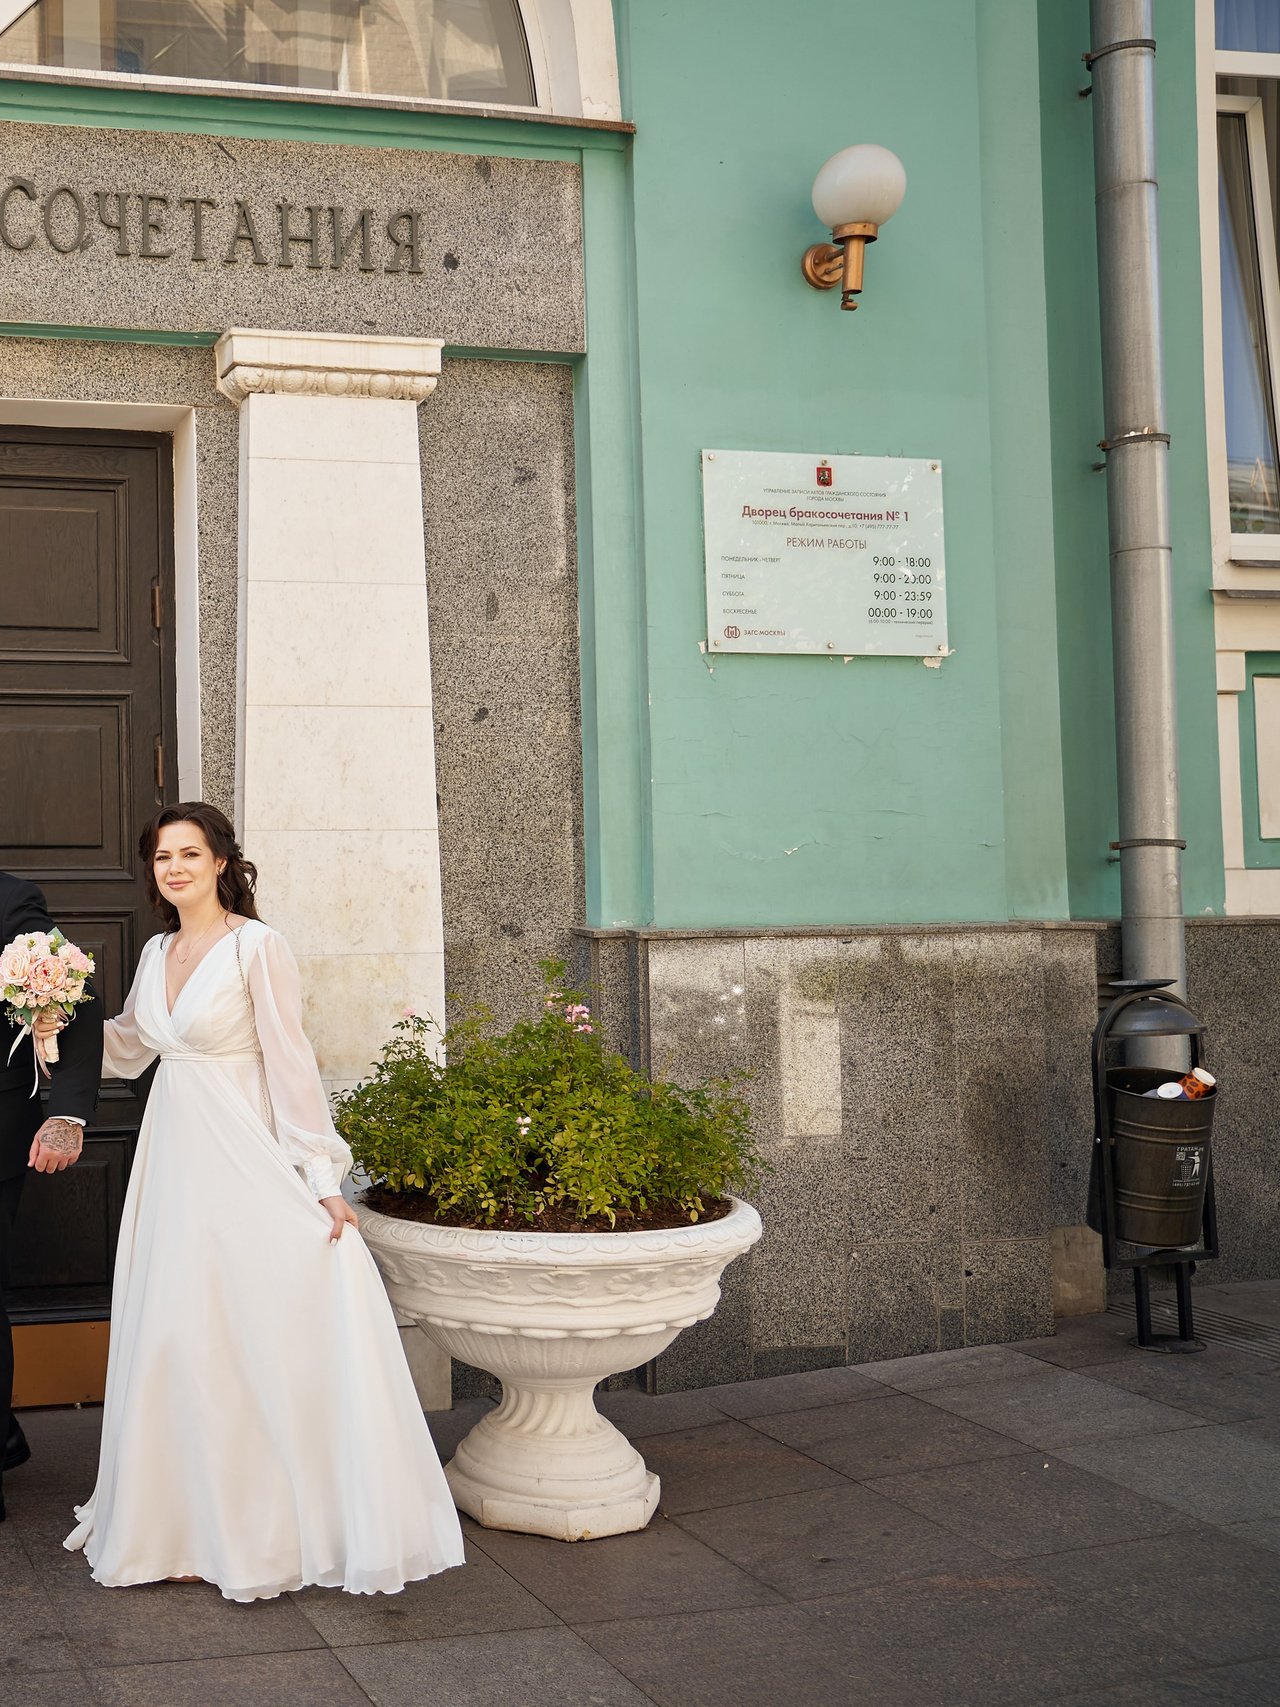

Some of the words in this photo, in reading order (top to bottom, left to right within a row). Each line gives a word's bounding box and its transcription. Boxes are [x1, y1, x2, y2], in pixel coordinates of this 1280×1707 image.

[742, 505, 787, 520] Дворец
[789, 507, 883, 521] бракосочетания
[886, 511, 900, 521] №
[904, 511, 909, 521] 1
[786, 537, 825, 548] РЕЖИМ
[827, 539, 867, 549] РАБОТЫ
[873, 556, 895, 566] 9:00
[905, 557, 931, 567] 18:00
[874, 573, 896, 583] 9:00
[904, 574, 932, 584] 20:00
[874, 590, 896, 600] 9:00
[904, 591, 932, 601] 23:59
[868, 607, 897, 618] 00:00
[907, 608, 933, 618] 19:00
